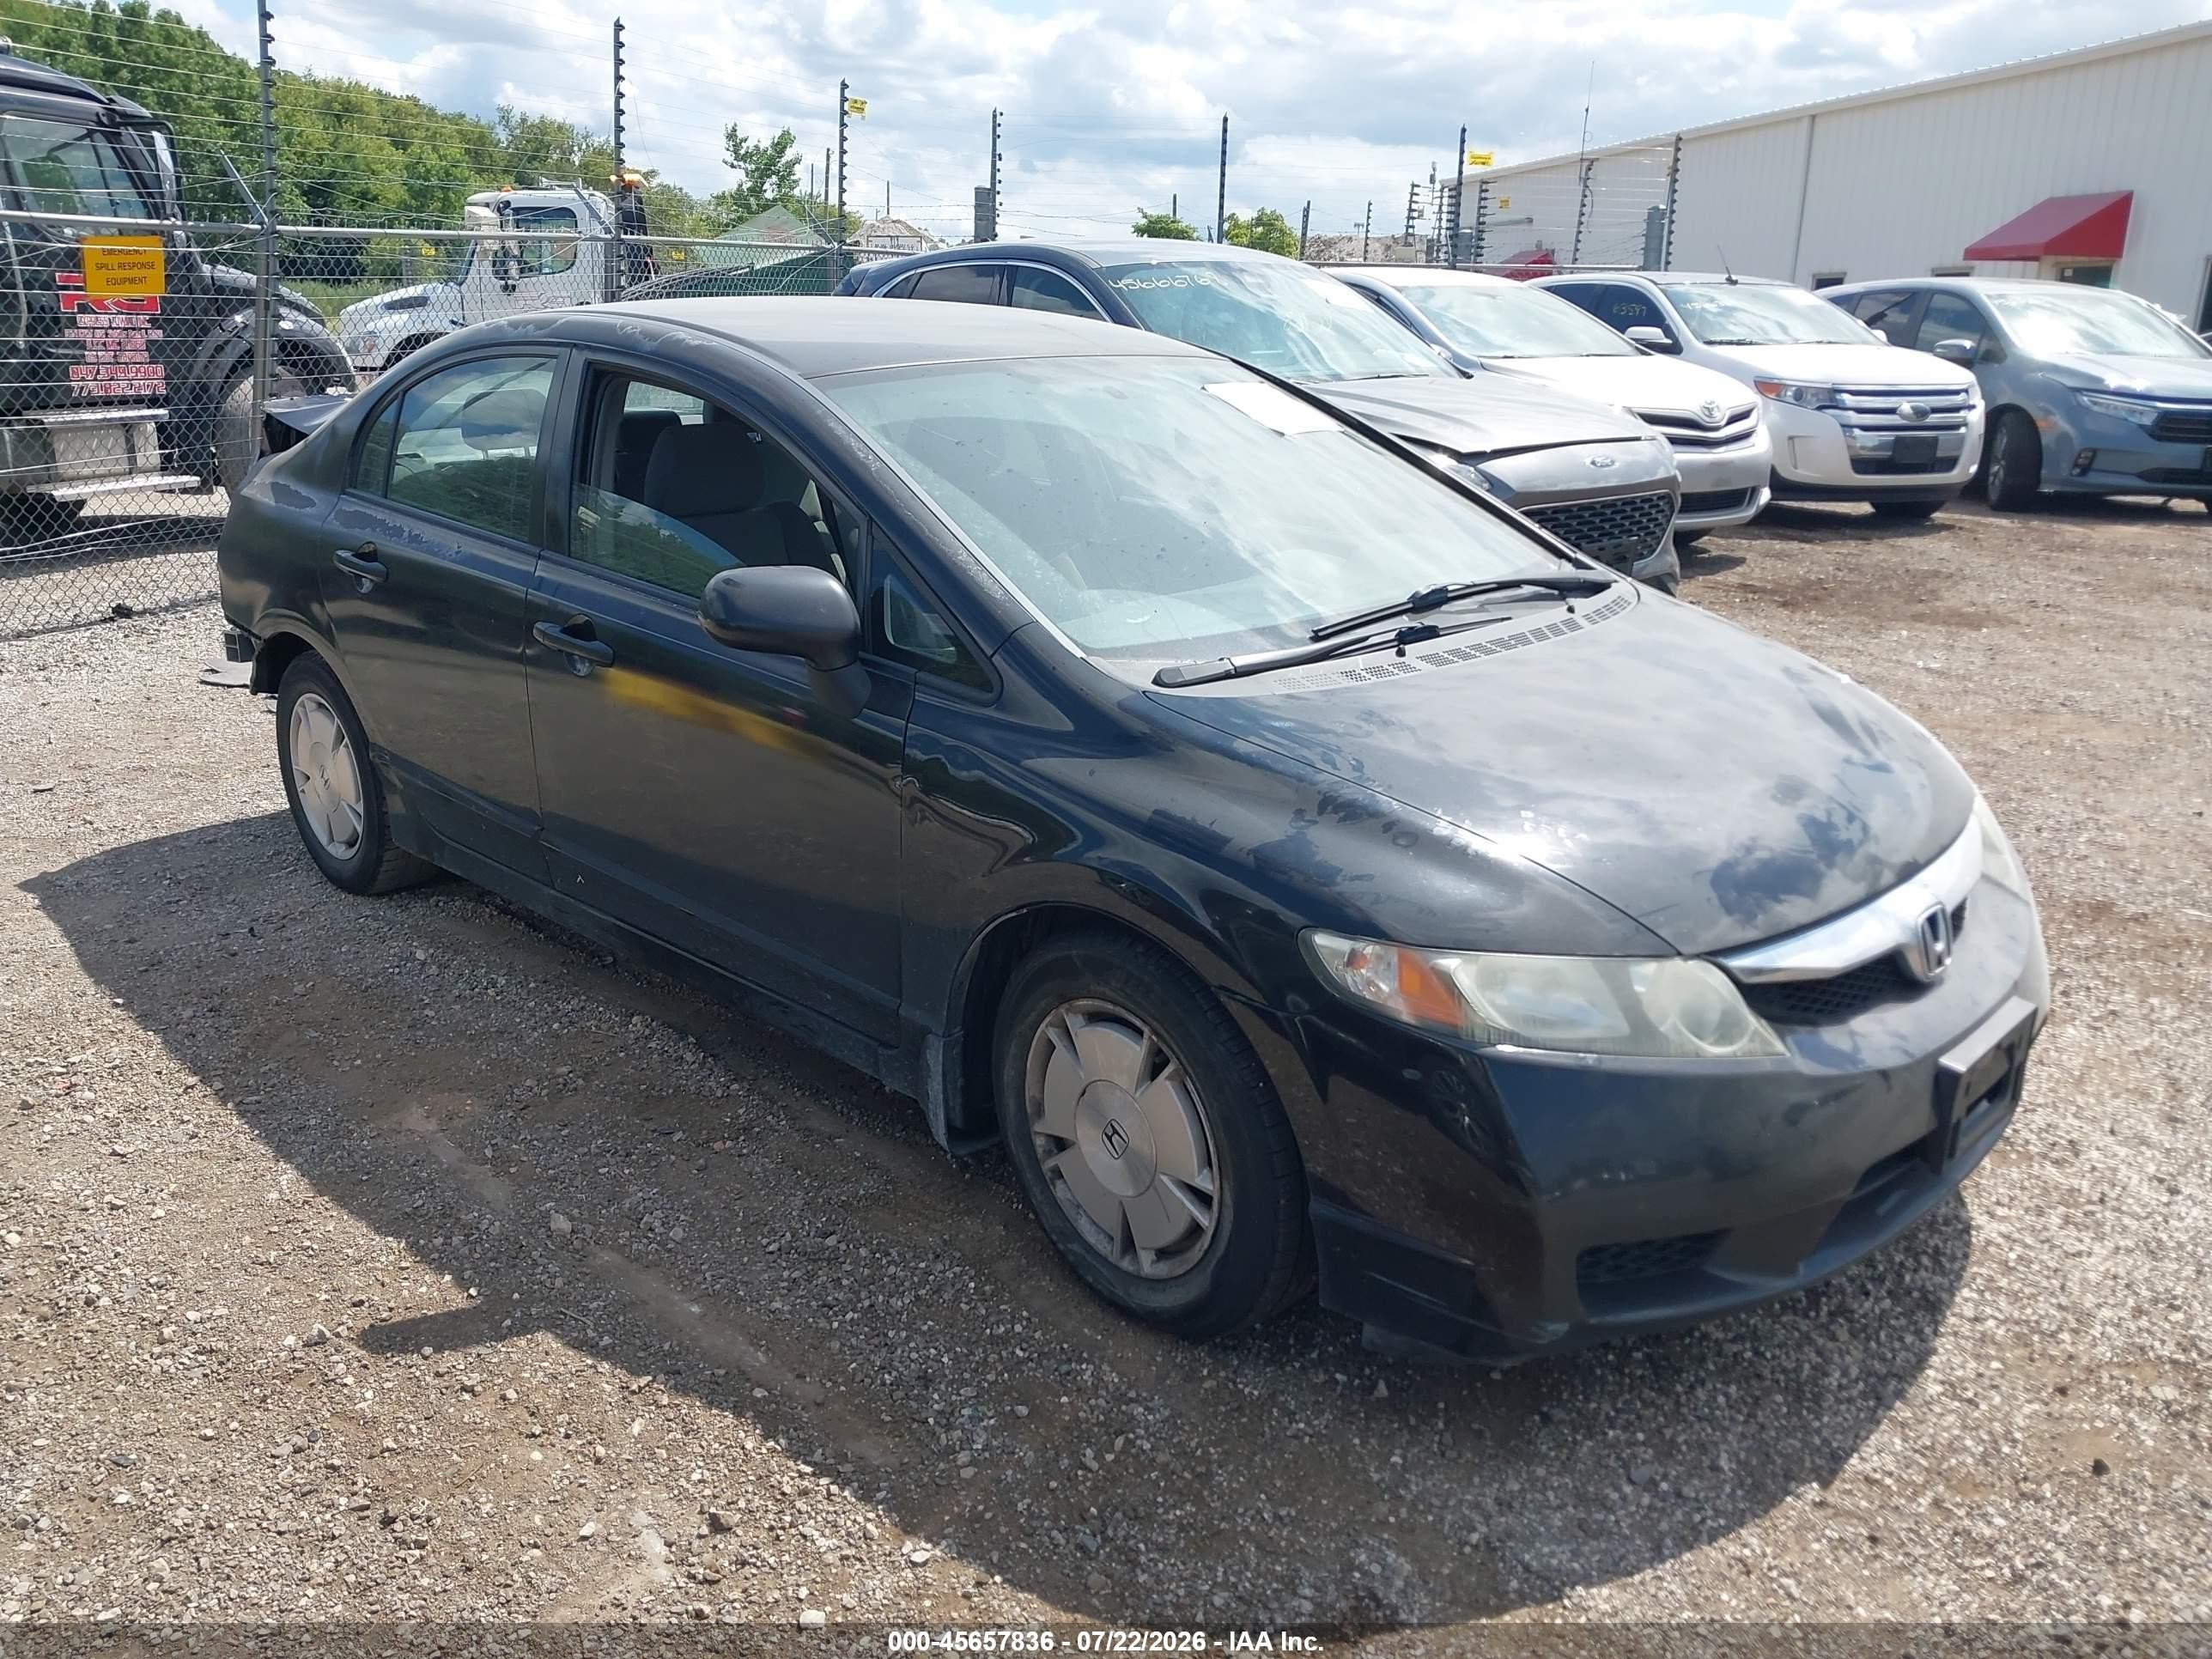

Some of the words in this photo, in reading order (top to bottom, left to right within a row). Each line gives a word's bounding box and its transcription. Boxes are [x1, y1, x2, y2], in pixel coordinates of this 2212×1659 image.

[101, 247, 147, 257] EMERGENCY
[95, 262, 116, 271] SPILL
[117, 261, 156, 270] RESPONSE
[106, 276, 148, 286] EQUIPMENT
